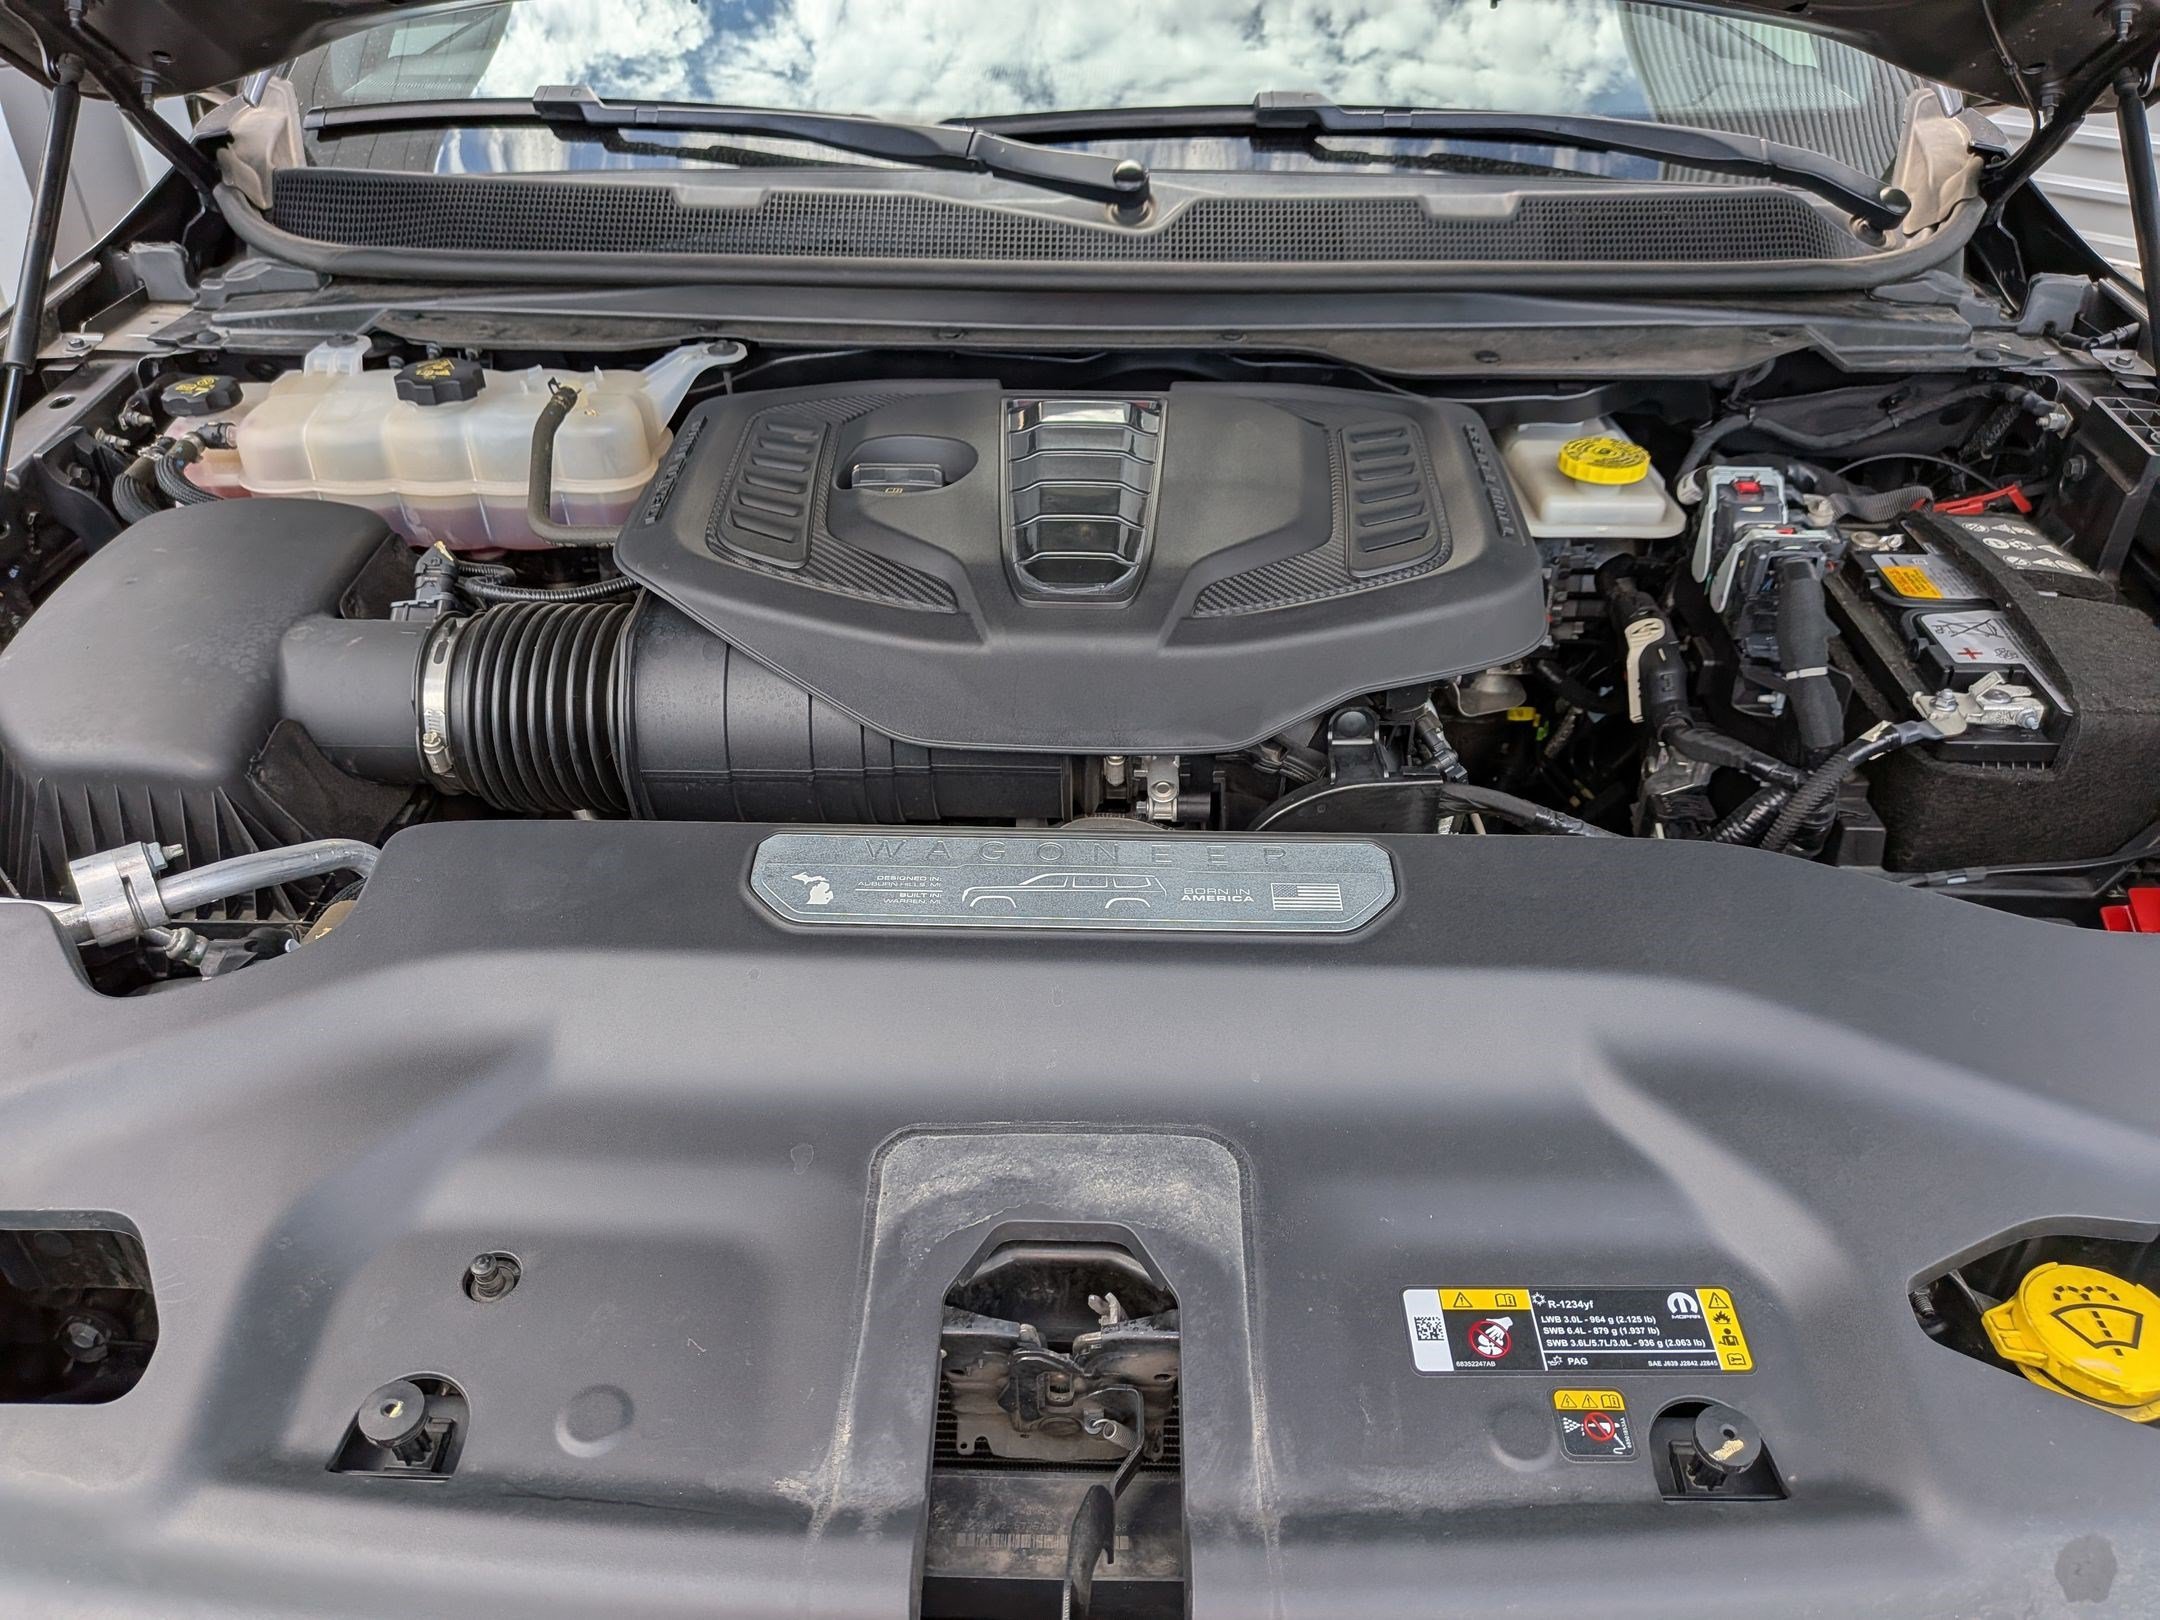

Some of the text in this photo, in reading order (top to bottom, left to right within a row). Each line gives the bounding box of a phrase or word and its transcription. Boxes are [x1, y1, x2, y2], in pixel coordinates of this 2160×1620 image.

[864, 838, 1287, 866] WAGONEER
[1183, 887, 1225, 895] BORN
[1548, 1300, 1594, 1310] R-1234yf
[1541, 1316, 1562, 1324] LWB
[1616, 1315, 1642, 1325] (2.125
[1644, 1315, 1656, 1325] lb)
[1543, 1327, 1565, 1335] SWB
[1619, 1327, 1645, 1336] (1.937
[1647, 1327, 1660, 1336] lb)
[1546, 1339, 1568, 1347] SWB
[1665, 1339, 1692, 1348] (2.063
[1693, 1339, 1706, 1348] lb)
[1567, 1358, 1588, 1366] PAG
